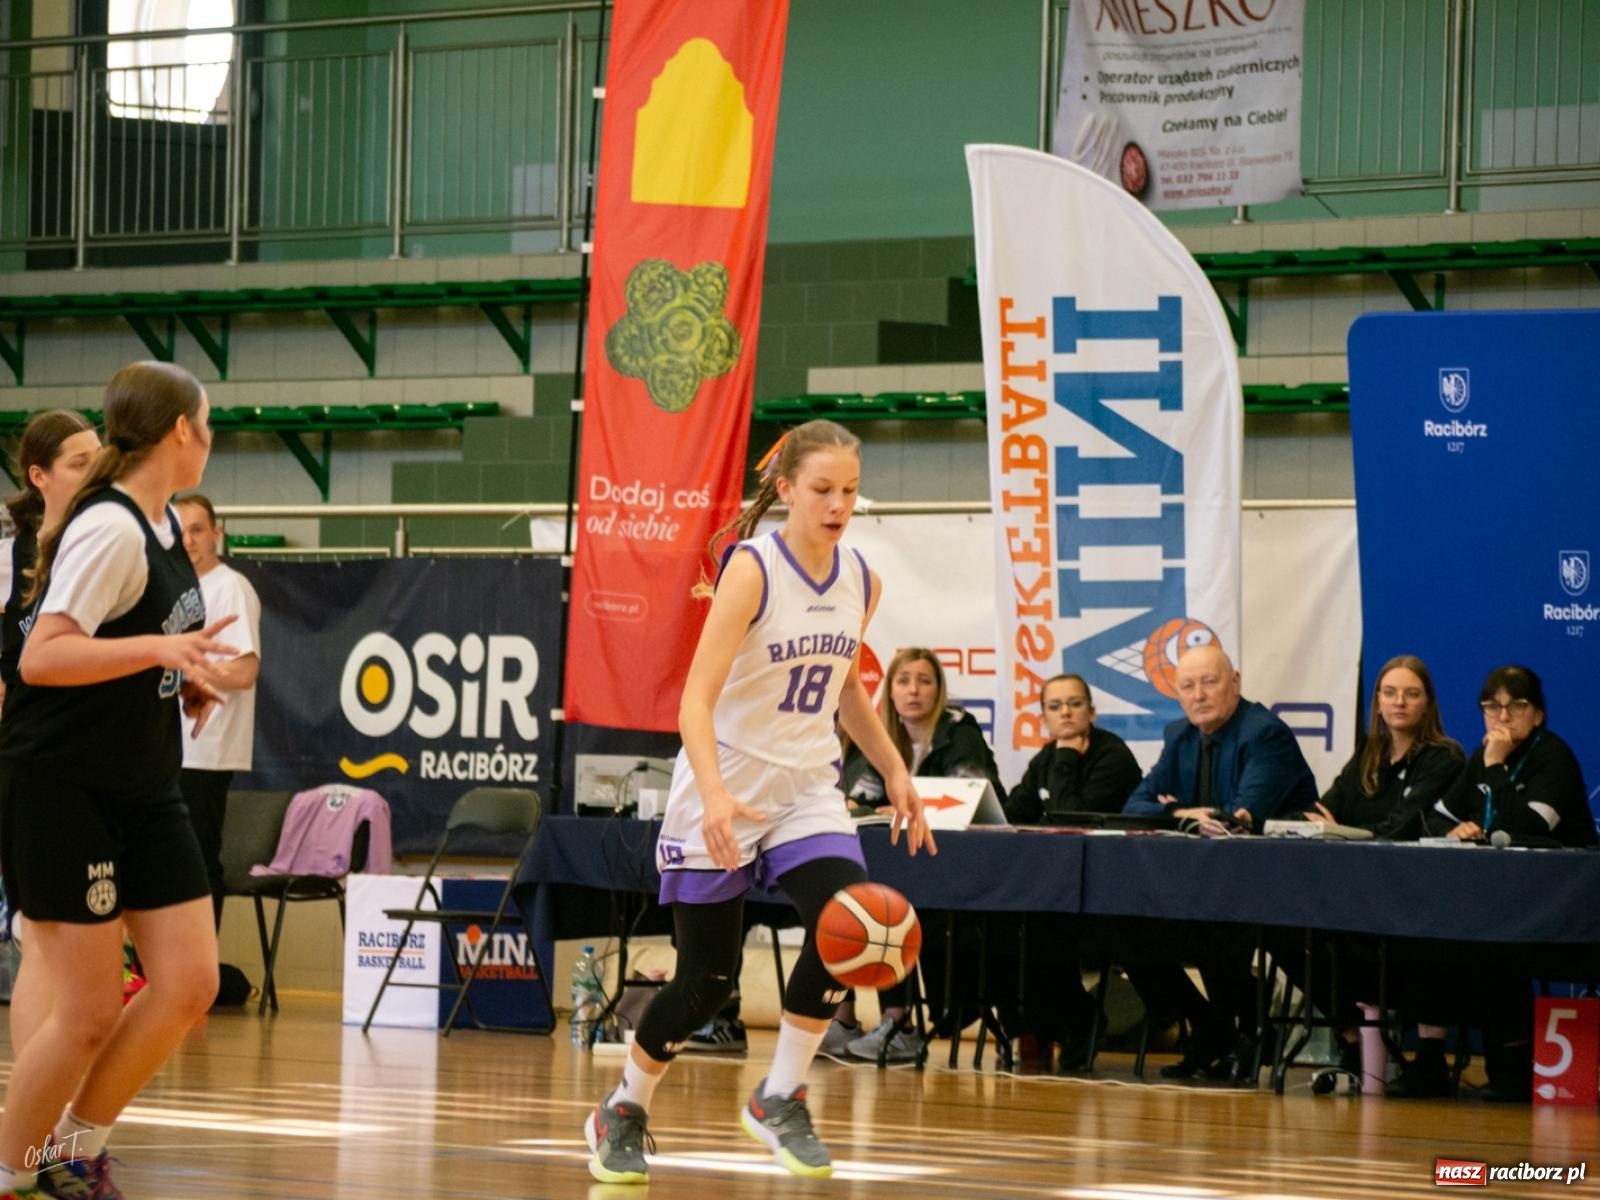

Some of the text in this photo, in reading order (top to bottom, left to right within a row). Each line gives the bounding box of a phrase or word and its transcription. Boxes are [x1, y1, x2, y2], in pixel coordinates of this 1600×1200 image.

[1097, 70, 1154, 87] Operator
[1223, 115, 1242, 127] na
[1424, 419, 1488, 437] Racibórz
[590, 475, 711, 514] Dodaj coś
[585, 510, 681, 542] od siebie
[1543, 602, 1600, 621] Racibór
[768, 631, 858, 664] RACIBÓR
[340, 631, 540, 741] OSiR
[778, 664, 834, 714] 18
[420, 743, 540, 782] RACIBÓRZ
[358, 931, 426, 949] RACIBRZ
[1532, 1008, 1578, 1078] 5
